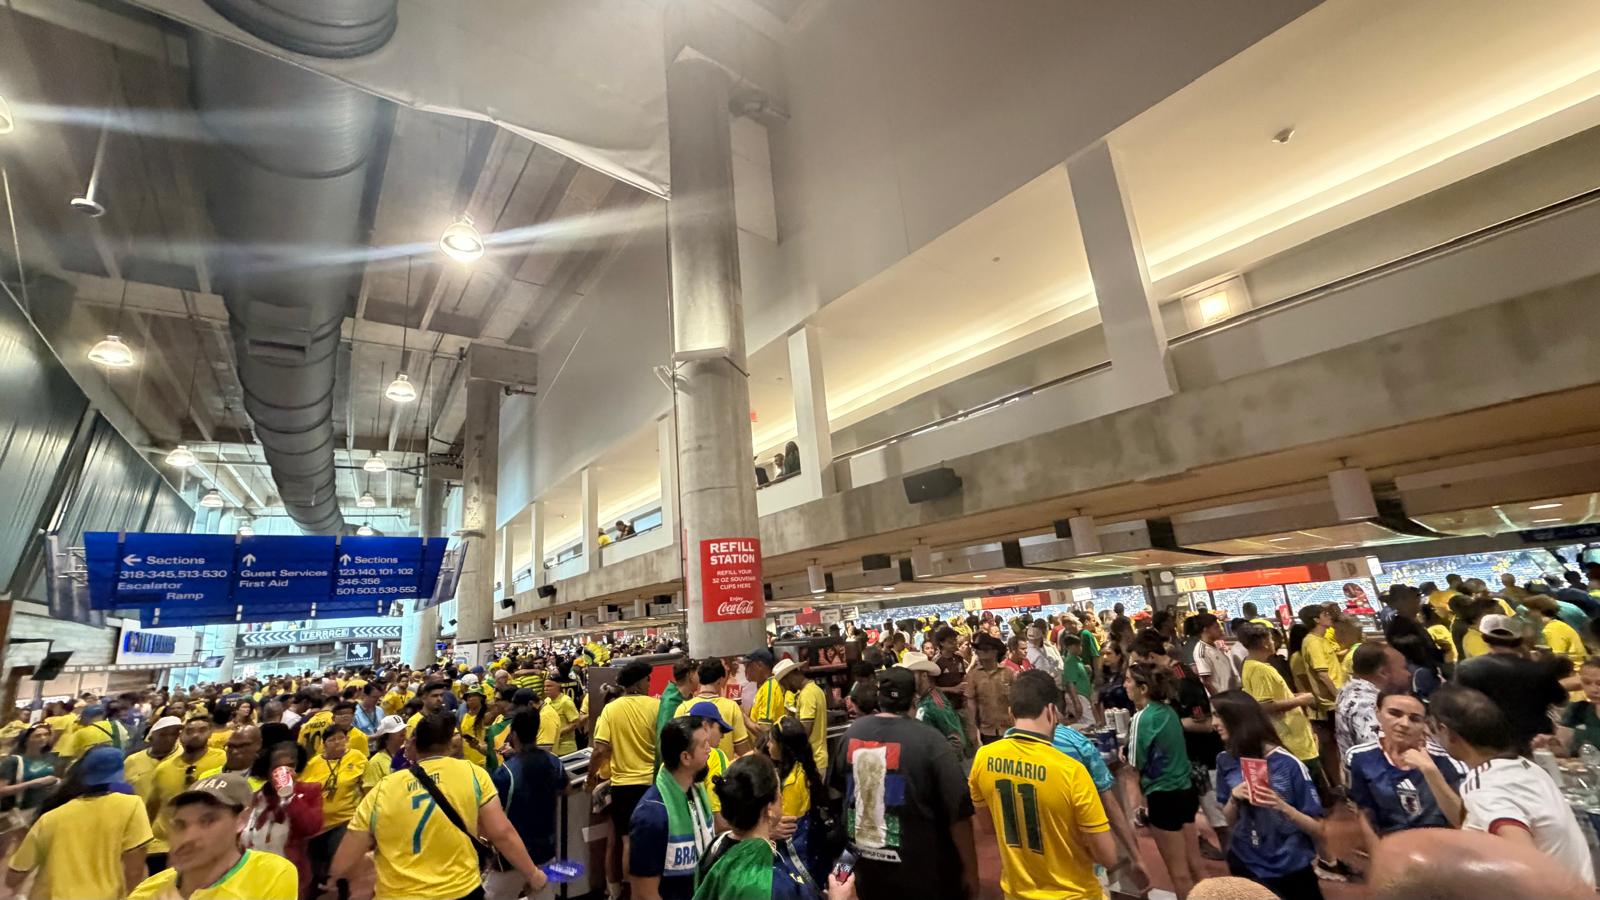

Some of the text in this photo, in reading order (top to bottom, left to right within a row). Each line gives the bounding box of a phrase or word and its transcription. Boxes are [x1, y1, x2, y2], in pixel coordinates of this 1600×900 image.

[710, 542, 755, 554] REFILL
[146, 555, 206, 565] Sections
[353, 556, 398, 564] Sections
[709, 554, 755, 565] STATION
[240, 569, 328, 578] Guest Services
[117, 581, 183, 591] Escalator
[239, 579, 289, 588] First Aid
[166, 592, 204, 601] Ramp
[303, 628, 347, 640] TERRACE
[987, 756, 1047, 782] ROMÁRIO
[995, 778, 1045, 855] 11
[411, 792, 437, 855] 7
